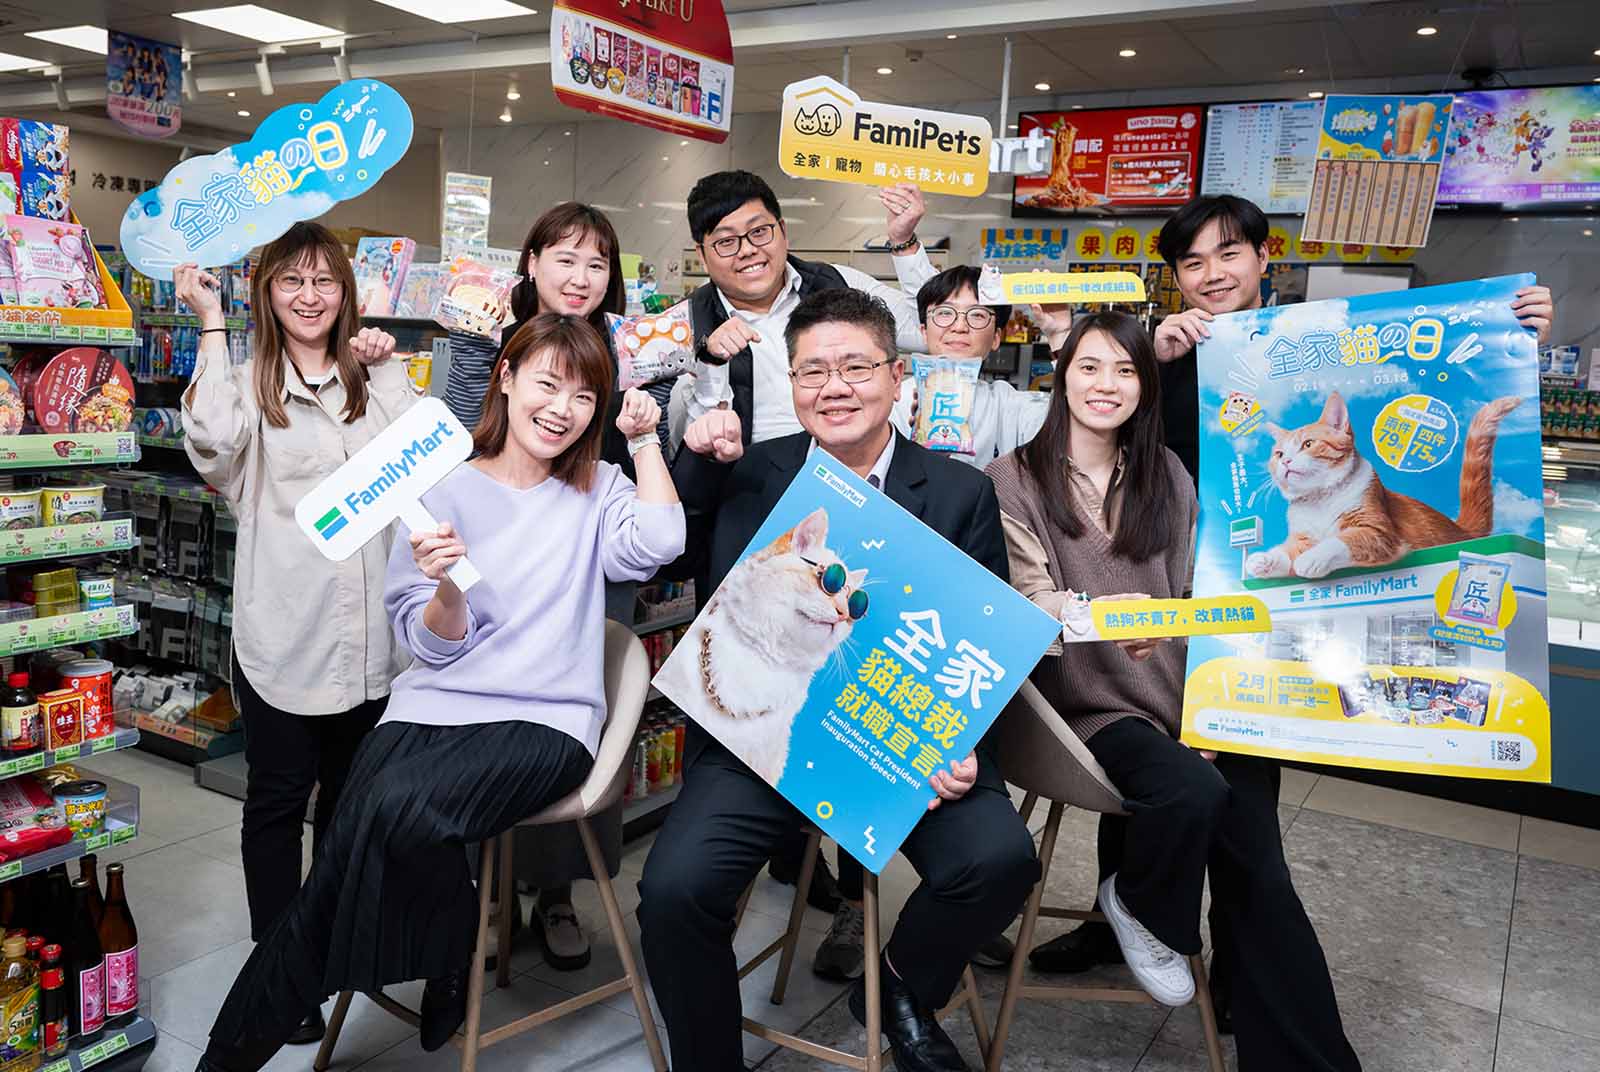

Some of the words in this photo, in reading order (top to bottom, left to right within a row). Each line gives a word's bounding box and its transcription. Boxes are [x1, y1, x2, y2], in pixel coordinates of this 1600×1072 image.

[793, 152, 821, 168] 全家
[835, 156, 862, 173] 寵物
[873, 160, 975, 186] 關心毛孩大小事
[854, 112, 981, 156] FamiPets
[170, 121, 349, 250] 全家貓の日
[1264, 317, 1445, 379] 全家貓の日
[343, 420, 454, 515] FamilyMart
[1309, 587, 1331, 600] 全家
[1335, 573, 1418, 598] FamilyMart
[883, 609, 1006, 710] 全家
[1235, 671, 1265, 690] 2月
[835, 682, 944, 778] 就職宣言
[857, 647, 969, 750] 貓總裁
[820, 718, 870, 763] Inauguration
[868, 758, 897, 786] Speech
[826, 709, 870, 748] FamilyMart
[868, 744, 885, 761] Cat
[883, 754, 921, 791] President
